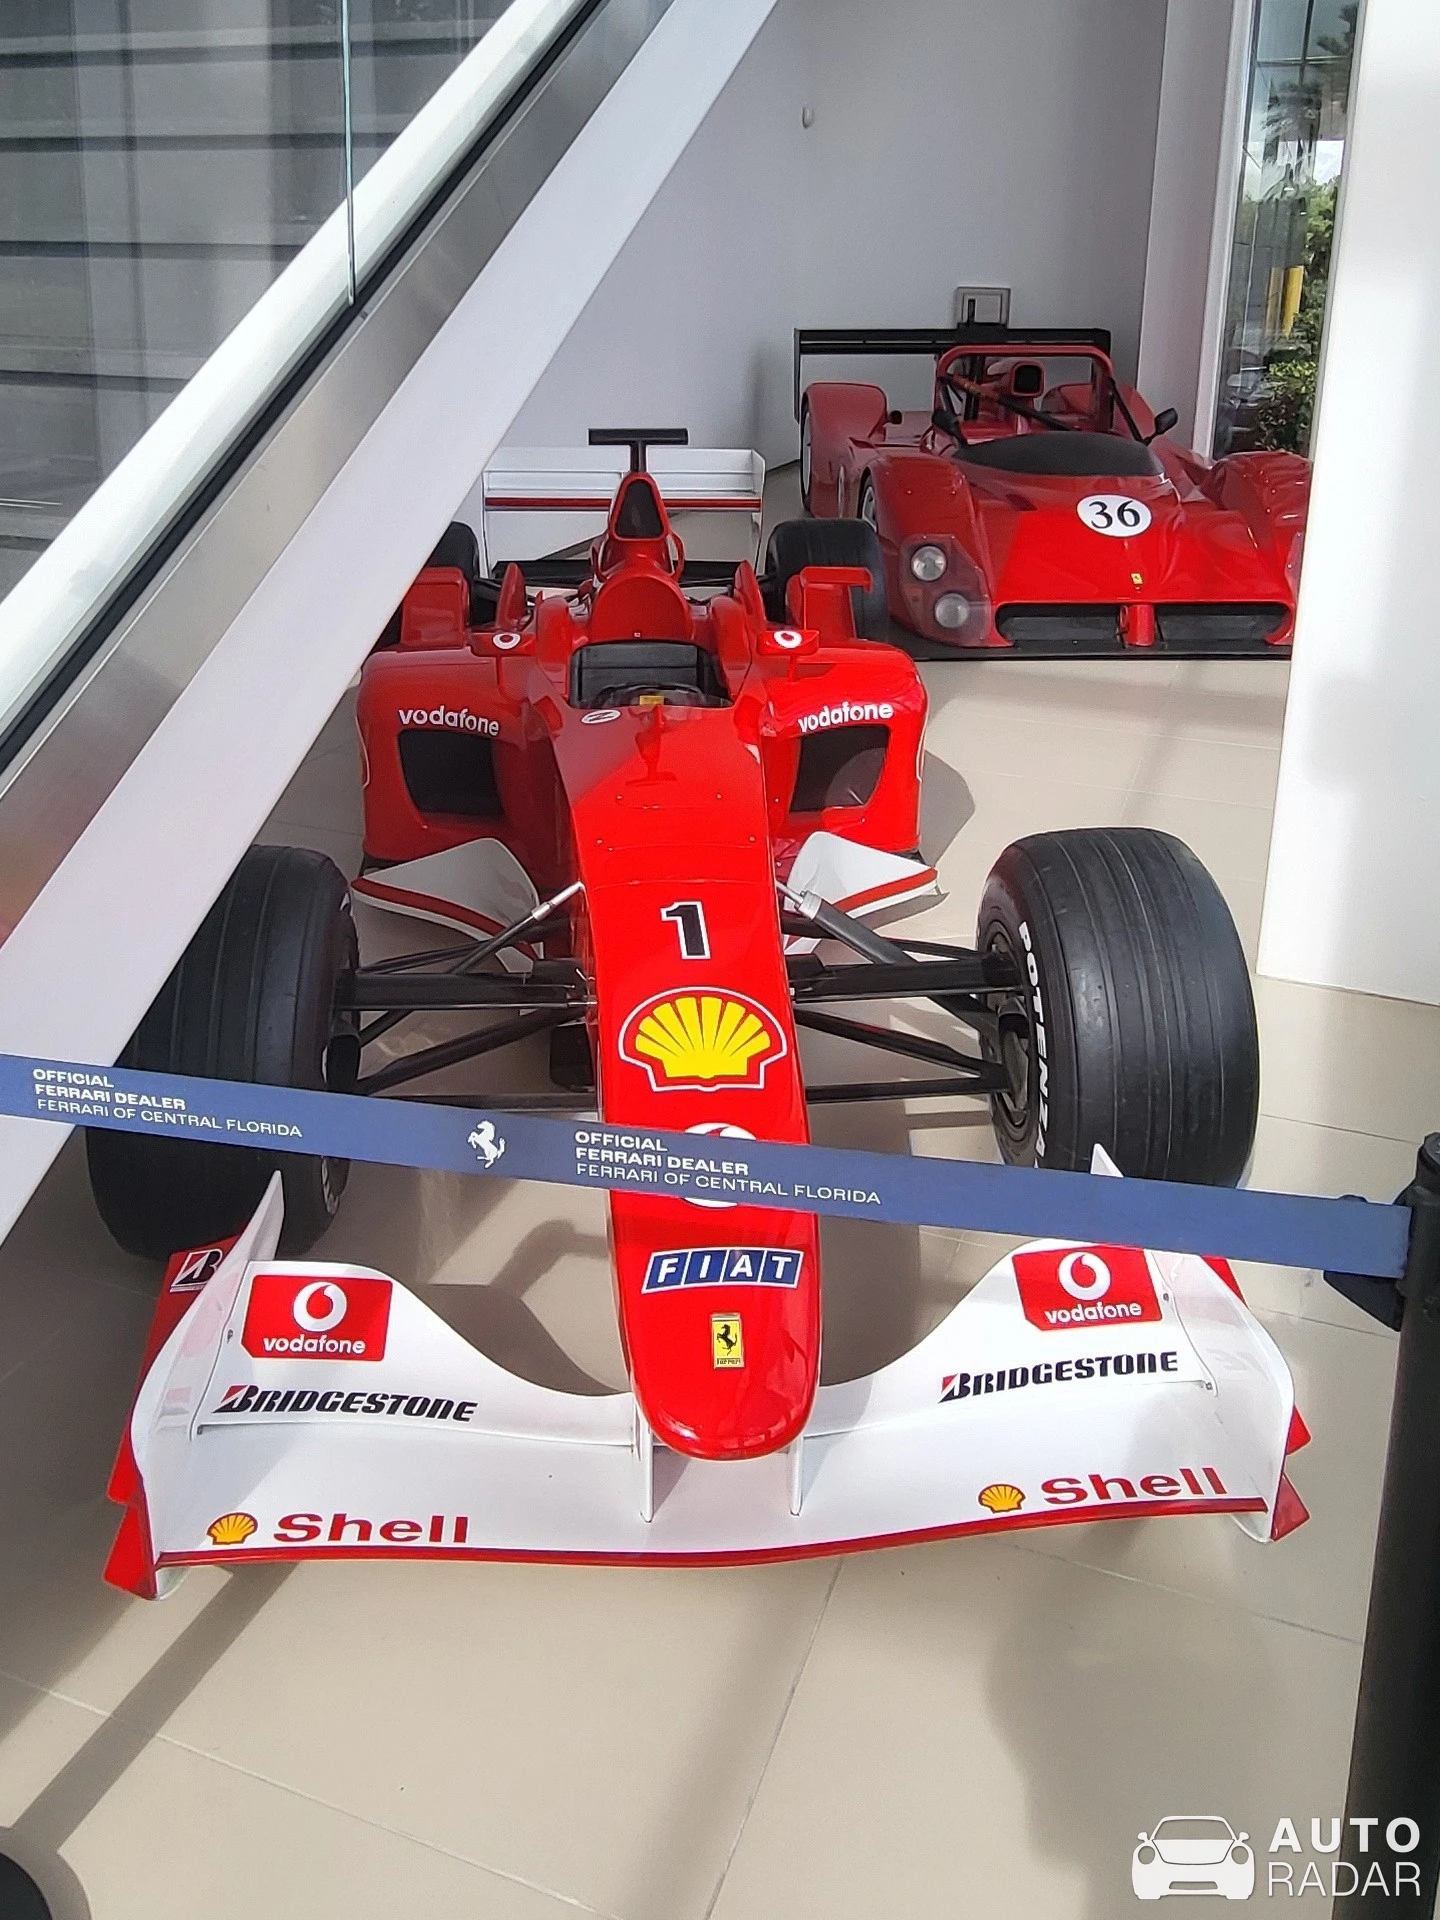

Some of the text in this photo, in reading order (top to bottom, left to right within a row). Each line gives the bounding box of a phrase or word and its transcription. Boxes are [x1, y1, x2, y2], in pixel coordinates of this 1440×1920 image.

[1089, 501, 1139, 528] 36
[398, 705, 500, 737] vodafone
[797, 701, 894, 734] vodafone
[660, 901, 711, 960] 1
[32, 1068, 115, 1089] OFFICIAL
[34, 1084, 187, 1112] FERRARI DEALER
[37, 1098, 303, 1139] FERRARI OF CENTRAL FLORIDA
[574, 1130, 668, 1152] OFFICIAL
[575, 1147, 750, 1177] FERRARI DEALER
[576, 1162, 882, 1206] FERRARI OF CENTRAL FLORIDA
[656, 1254, 792, 1283] FIAT
[1044, 1302, 1143, 1324] vodafone
[262, 1335, 366, 1354] vodafone
[938, 1351, 1178, 1404] BRIDGESTONE
[211, 1384, 478, 1422] BRIDGESTONE
[1040, 1467, 1228, 1505] Shell
[273, 1512, 469, 1544] Shell
